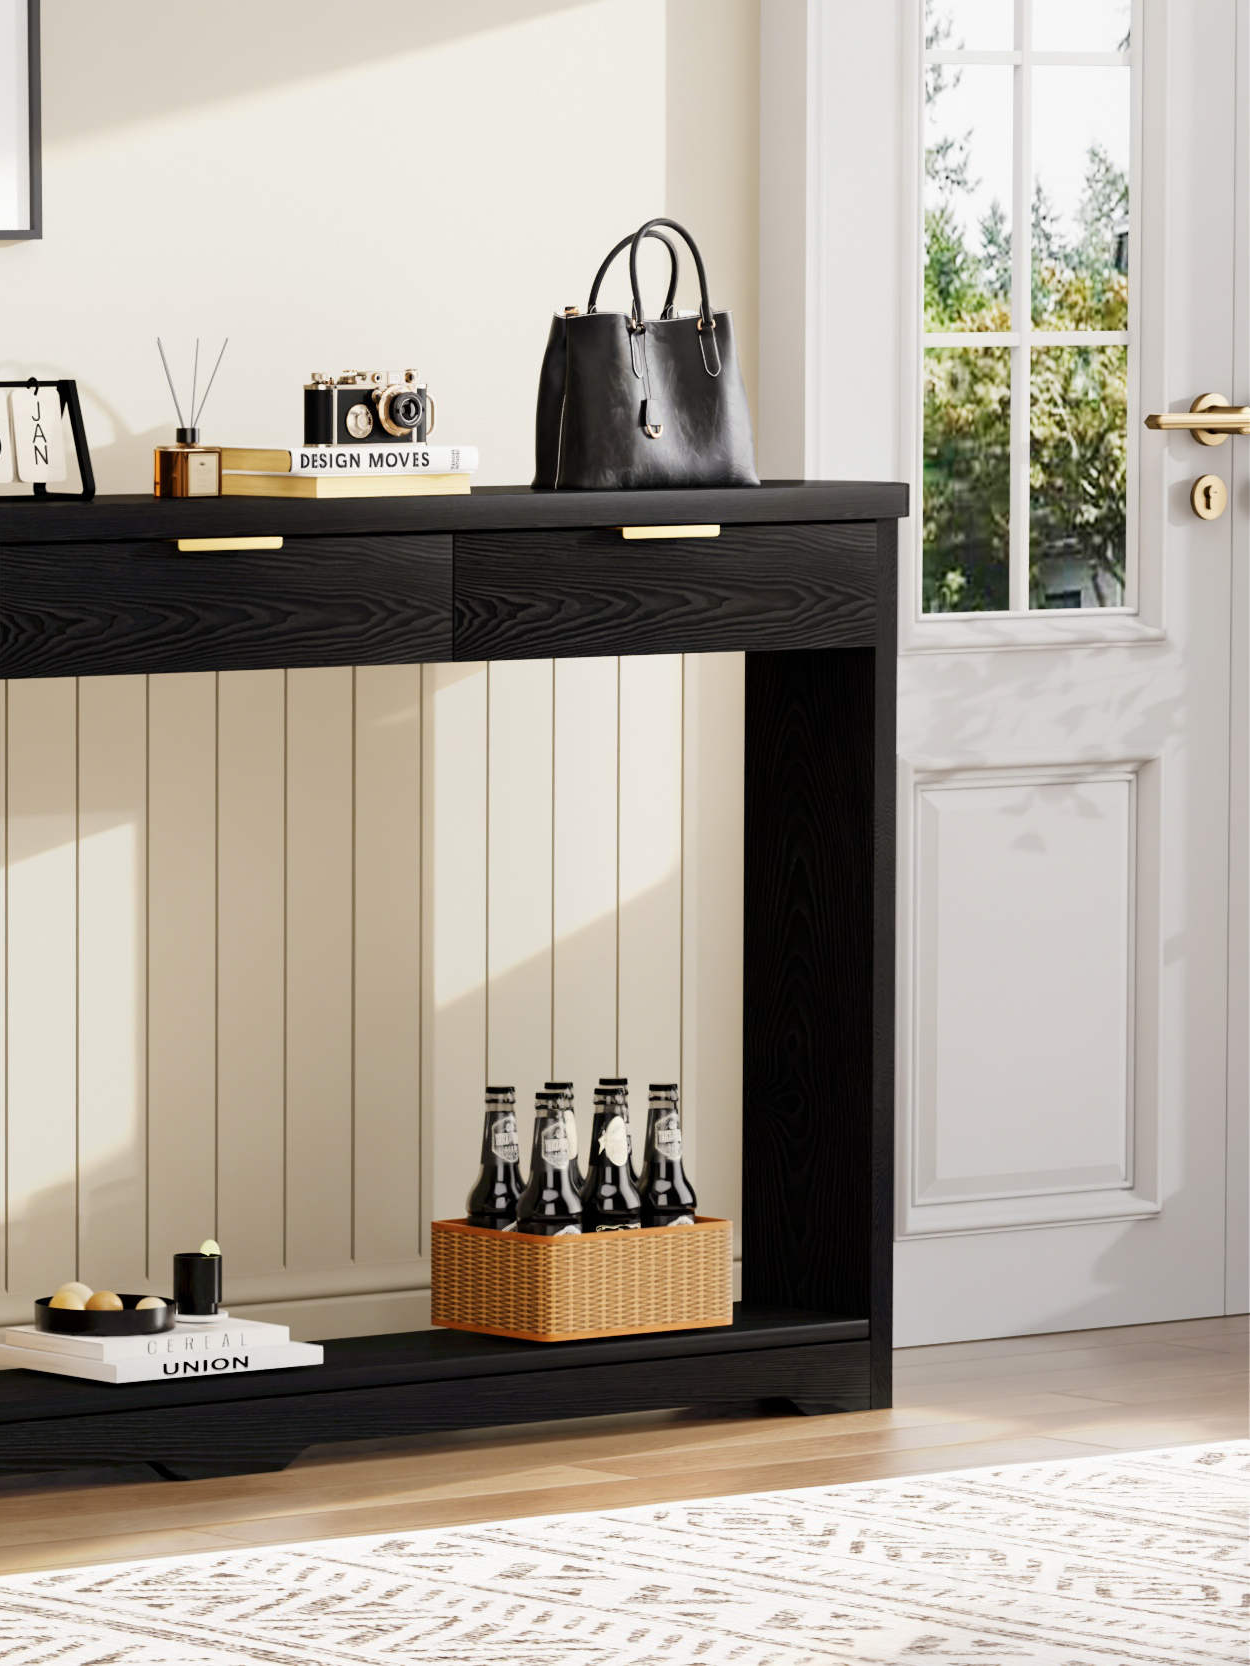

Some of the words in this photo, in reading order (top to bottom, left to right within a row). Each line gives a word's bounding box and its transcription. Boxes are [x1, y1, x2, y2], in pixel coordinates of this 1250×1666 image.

[31, 401, 49, 465] JAN
[300, 453, 361, 469] DESIGN
[368, 452, 430, 468] MOVES
[147, 1332, 248, 1355] CEREAL
[163, 1356, 249, 1375] UNION
